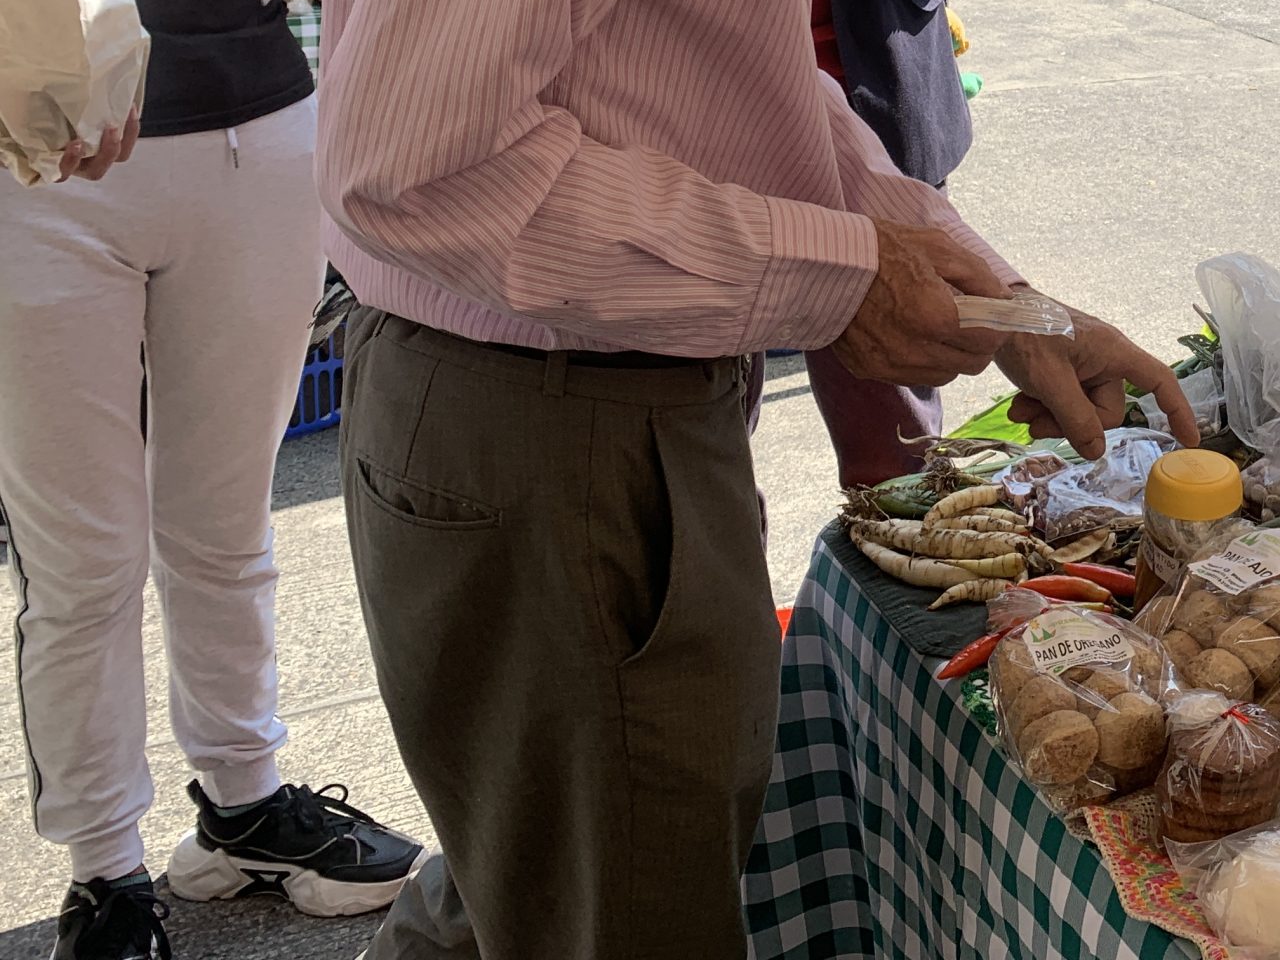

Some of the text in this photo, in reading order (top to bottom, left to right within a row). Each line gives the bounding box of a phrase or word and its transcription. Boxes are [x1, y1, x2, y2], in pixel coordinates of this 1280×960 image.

[1248, 562, 1273, 578] AJO
[1035, 645, 1057, 662] PAN
[1059, 640, 1073, 657] DE
